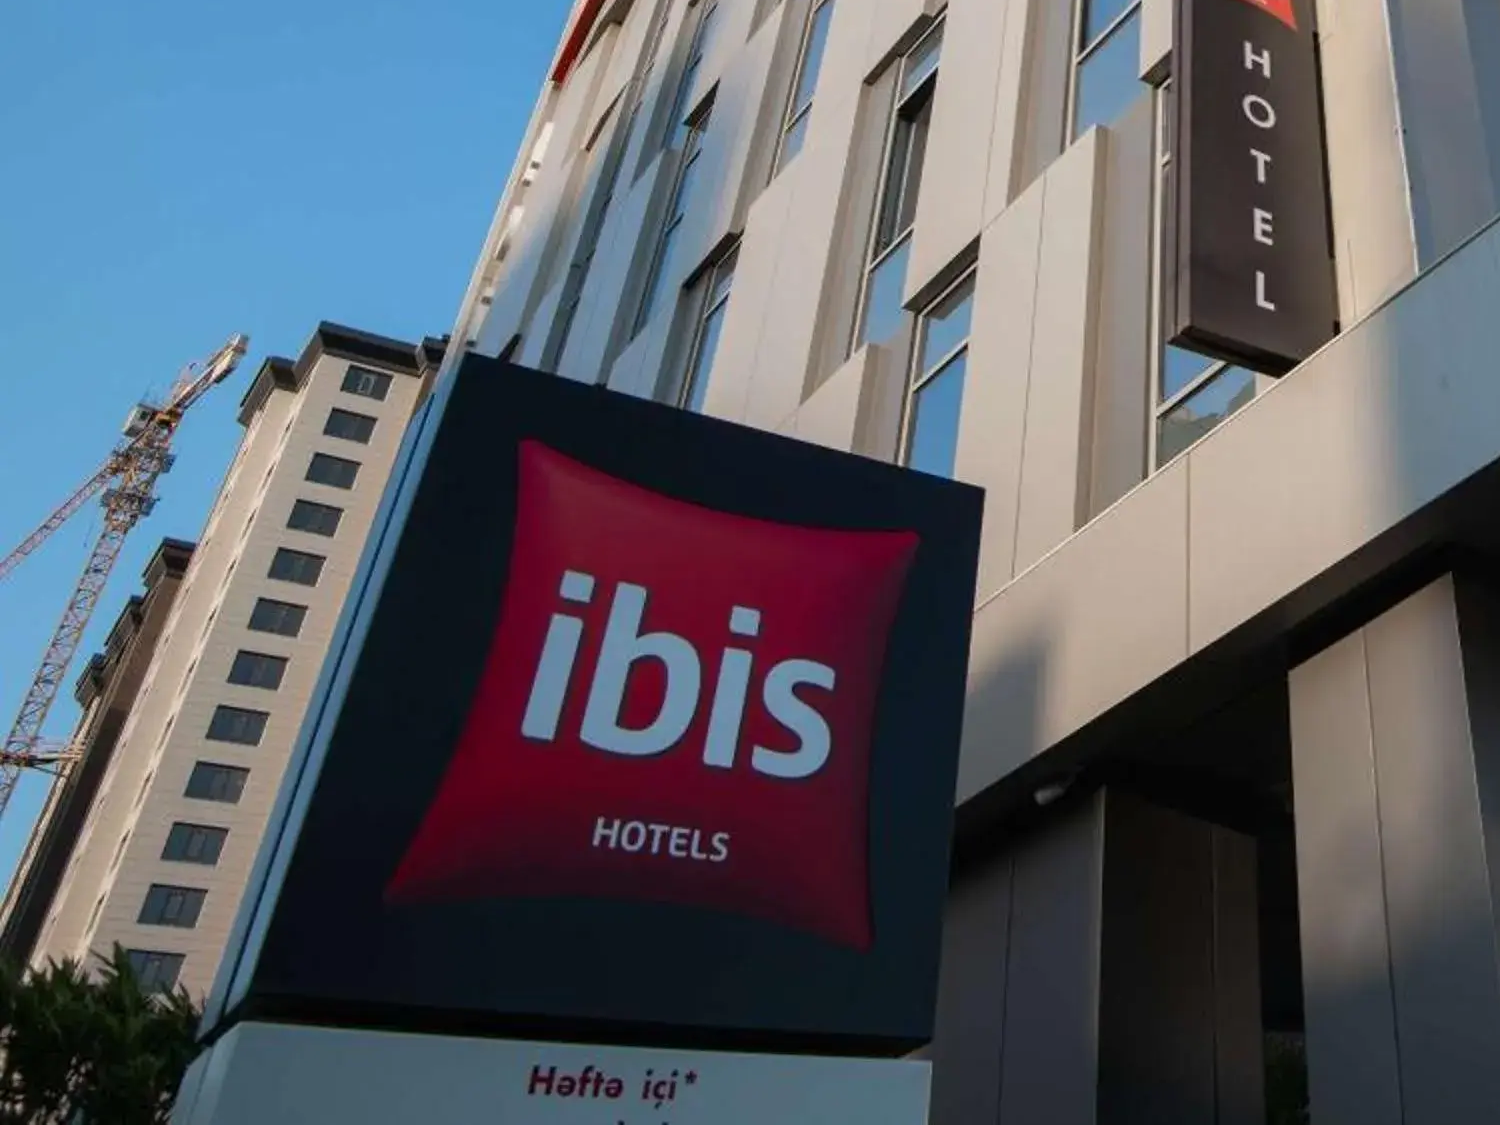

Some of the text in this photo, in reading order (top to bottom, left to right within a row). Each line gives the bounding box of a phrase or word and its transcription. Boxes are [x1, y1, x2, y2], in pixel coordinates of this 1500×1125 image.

[1242, 40, 1277, 312] HOTEL
[520, 568, 836, 779] ibis
[591, 817, 731, 863] HOTELS
[527, 1064, 624, 1098] Həftə
